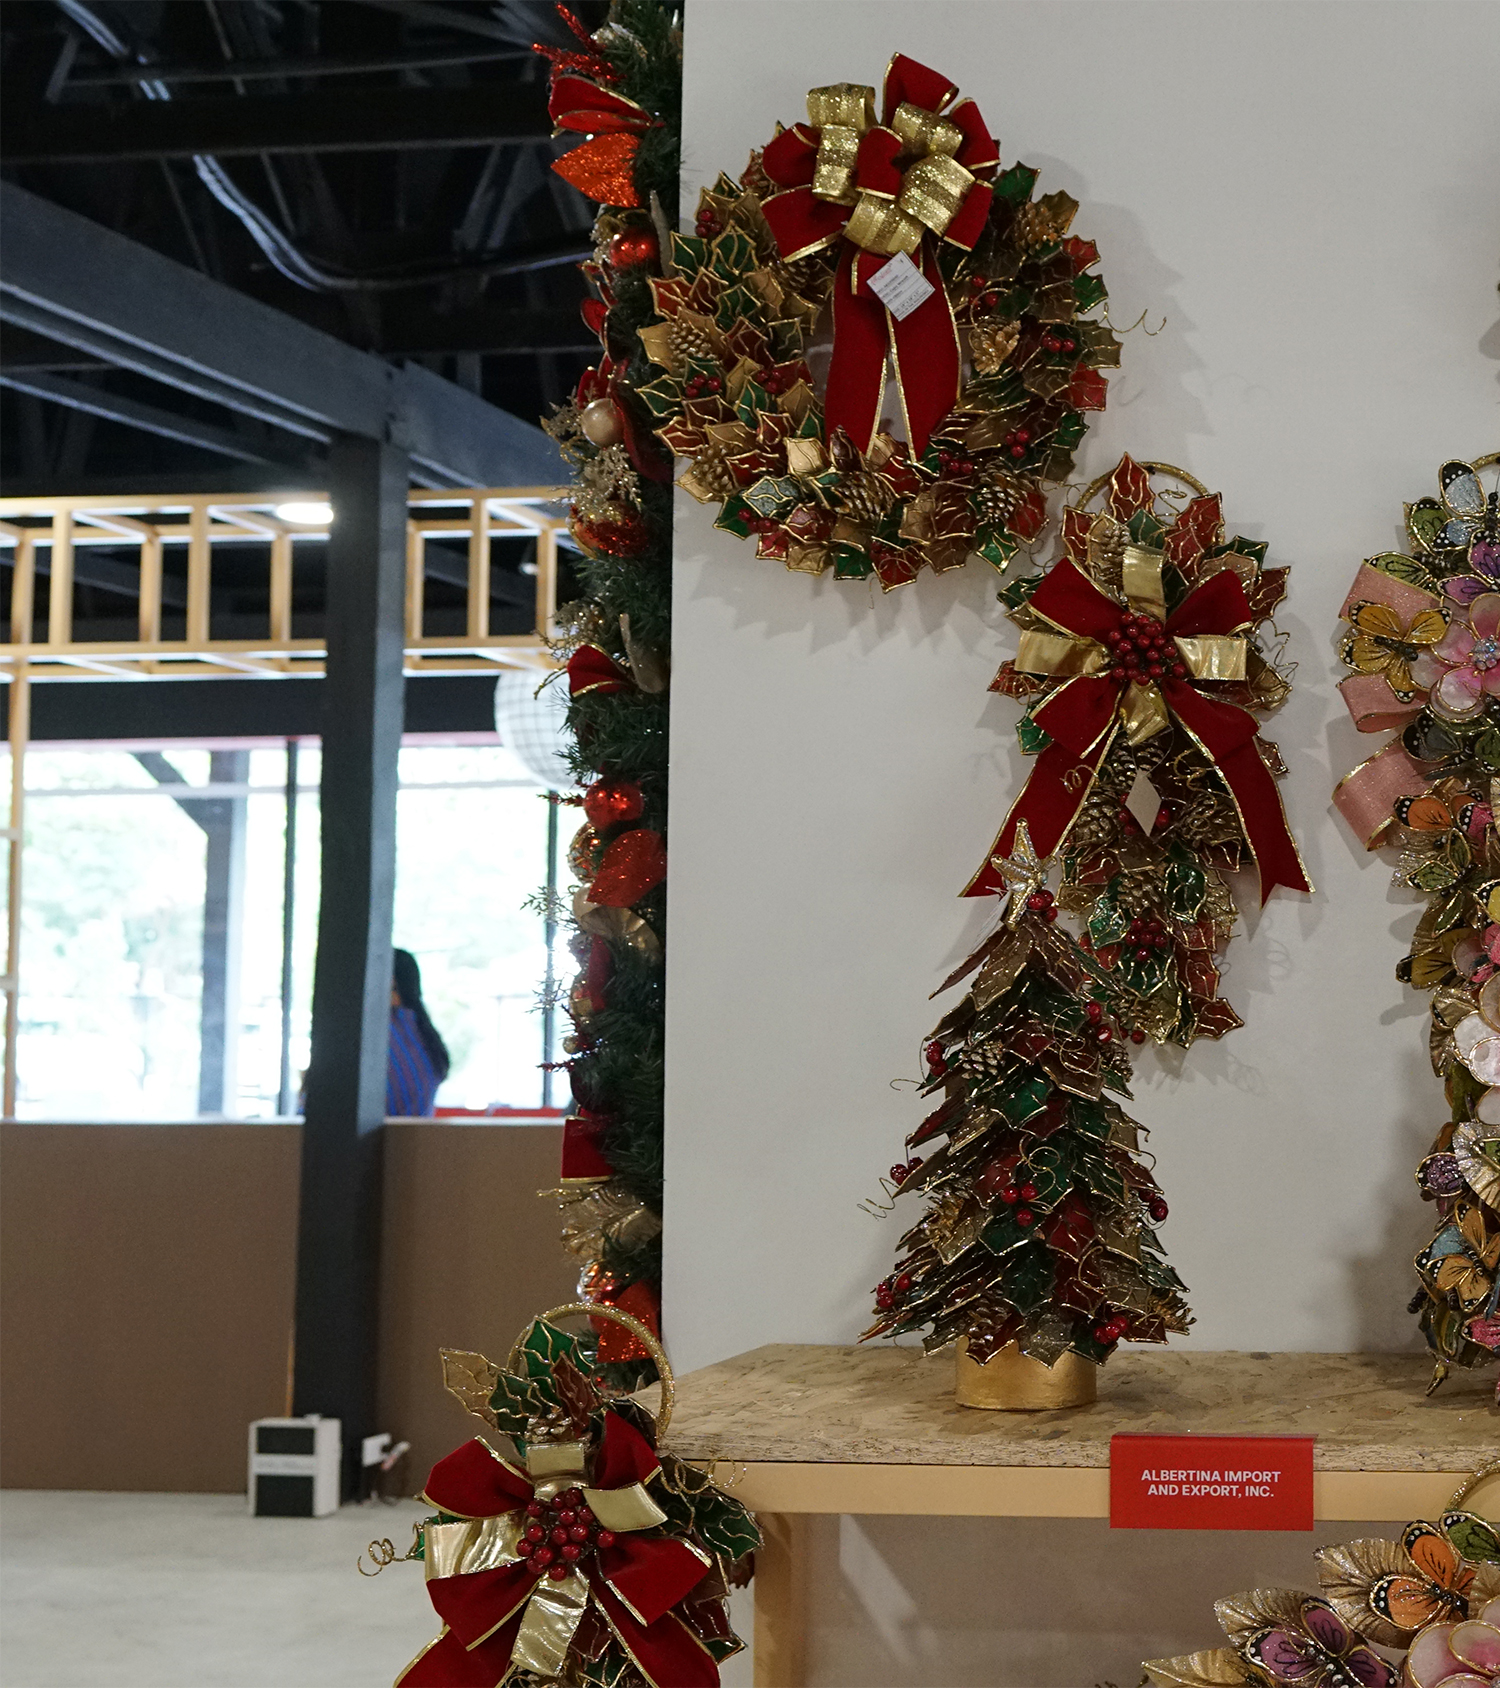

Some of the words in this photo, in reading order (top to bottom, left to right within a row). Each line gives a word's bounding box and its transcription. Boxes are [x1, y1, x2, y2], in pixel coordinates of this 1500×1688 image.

[1141, 1470, 1221, 1482] ALBERTINA
[1224, 1471, 1281, 1483] IMPORT
[1147, 1484, 1179, 1496] AND
[1182, 1485, 1242, 1498] EXPORT,
[1245, 1485, 1275, 1497] INC.
